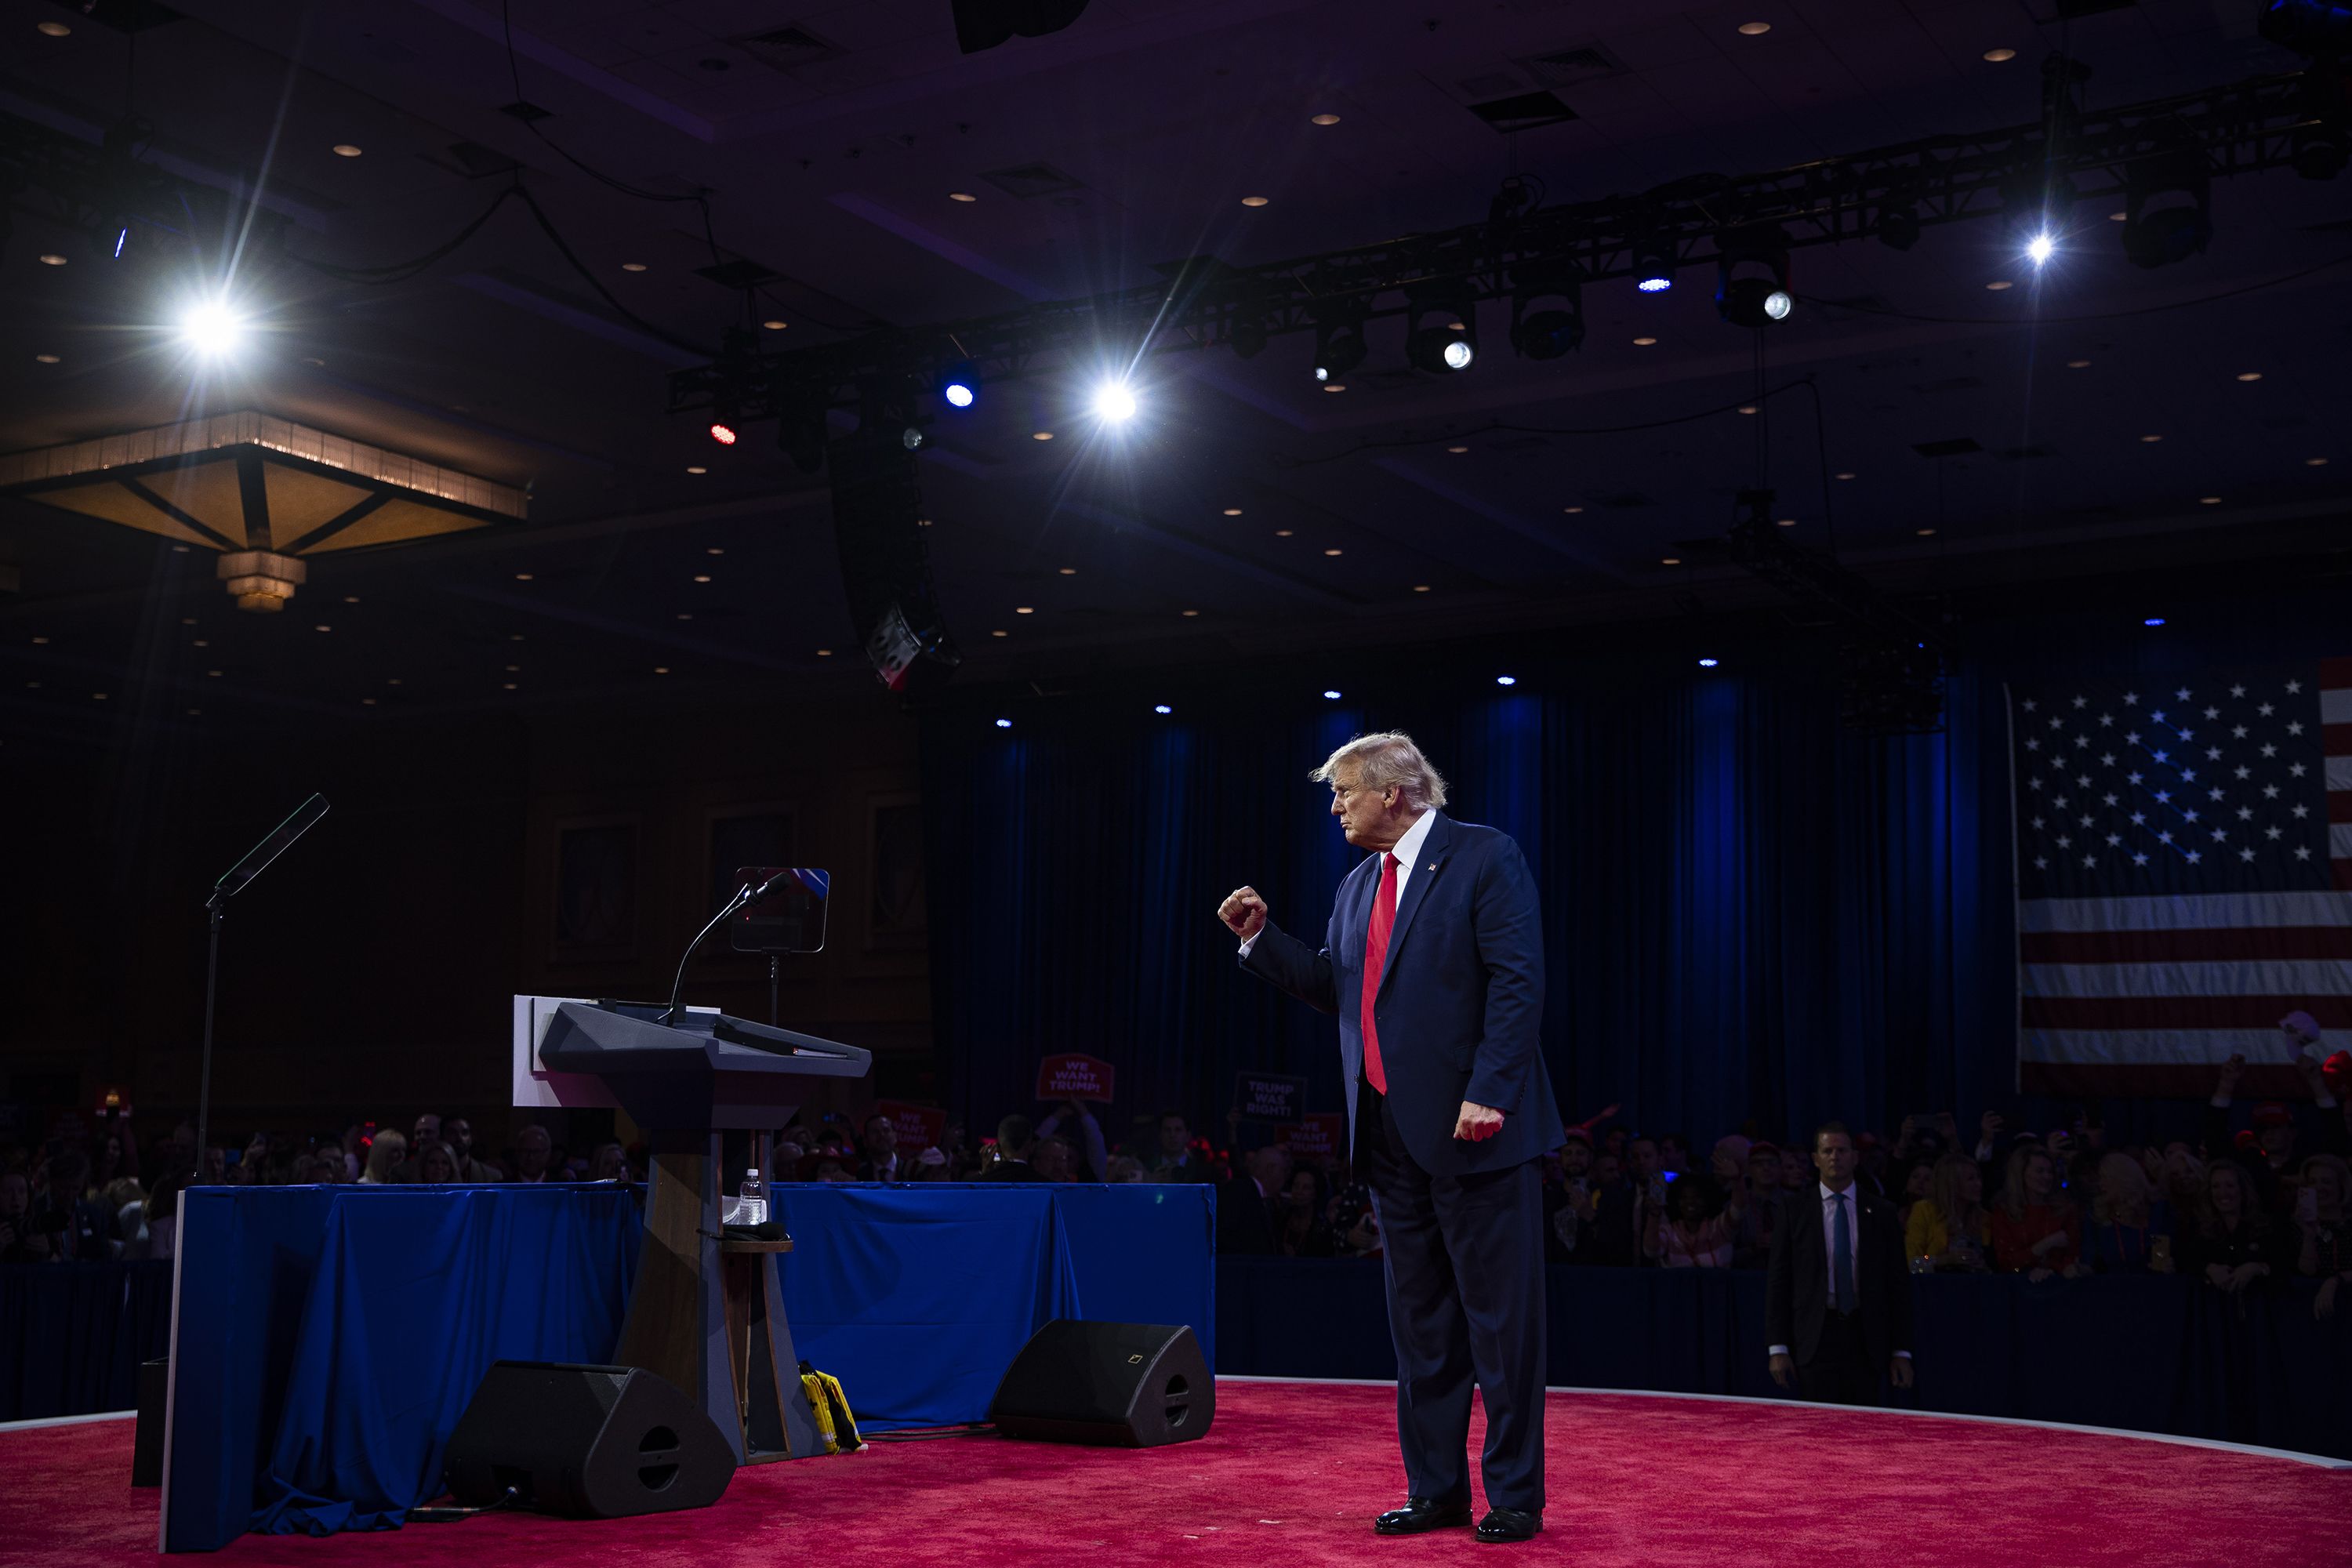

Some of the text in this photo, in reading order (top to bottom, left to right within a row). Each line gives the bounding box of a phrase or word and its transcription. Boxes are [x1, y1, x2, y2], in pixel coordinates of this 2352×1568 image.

[1066, 1061, 1089, 1070] WE
[1055, 1070, 1097, 1081] WANT
[1049, 1080, 1100, 1093] TRUMP!
[1248, 1080, 1294, 1094] TRUMP
[1254, 1093, 1285, 1104] WAS
[1247, 1103, 1291, 1116] RIGHT!
[899, 1111, 921, 1123] WE
[1290, 1130, 1328, 1142] WANT
